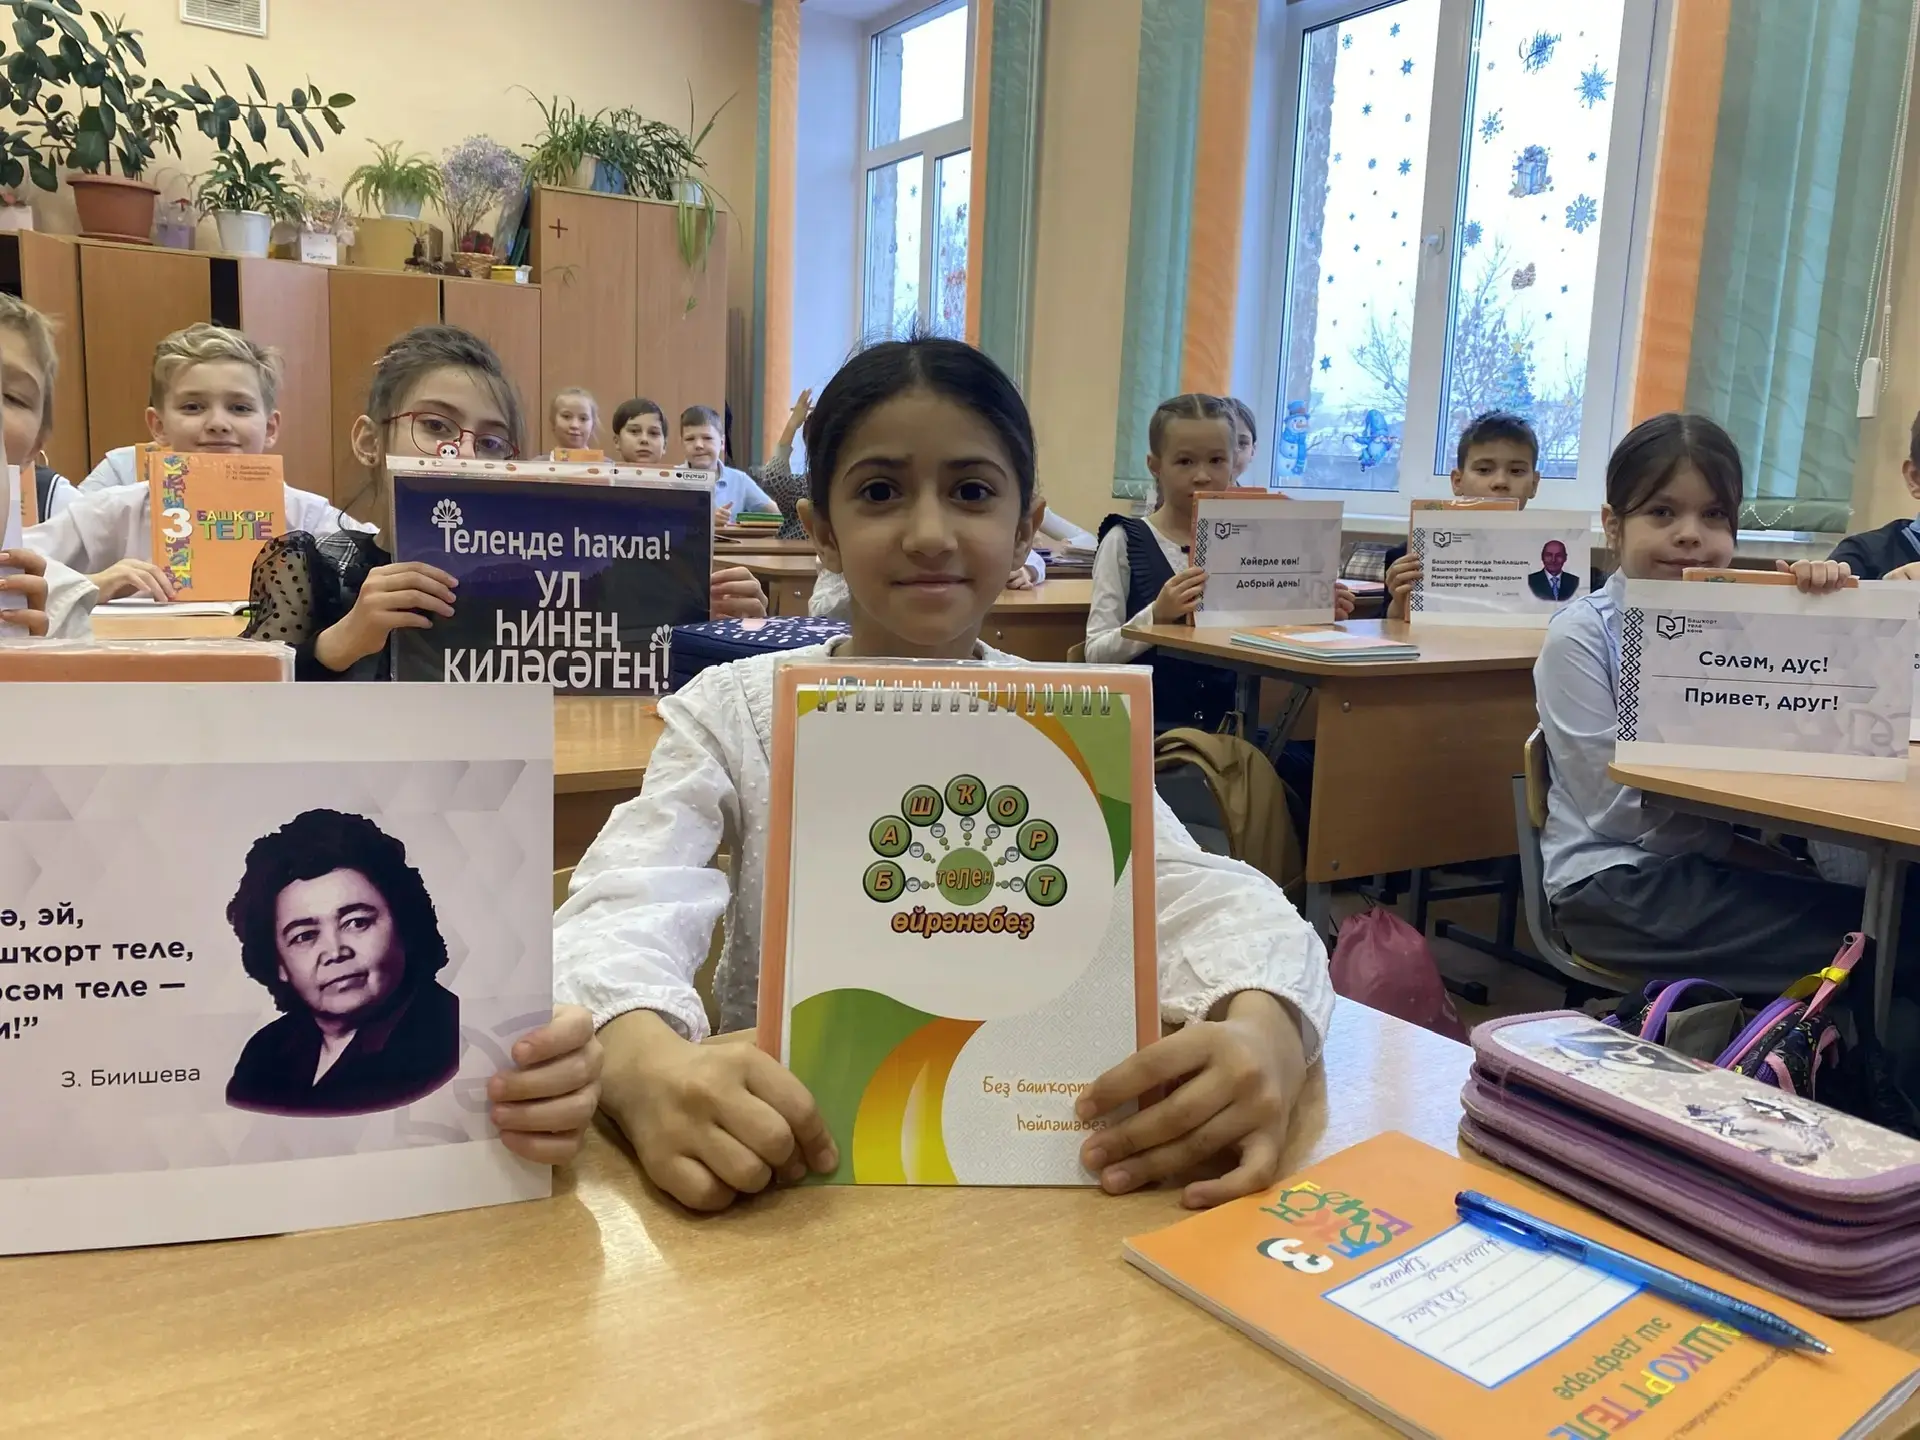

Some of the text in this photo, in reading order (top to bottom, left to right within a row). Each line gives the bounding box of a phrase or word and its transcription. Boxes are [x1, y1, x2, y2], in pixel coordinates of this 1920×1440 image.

[162, 508, 192, 538] 3
[199, 520, 272, 540] ТЕЛЕ
[437, 521, 671, 560] Телеңде һаҡла!
[534, 570, 581, 609] УЛ
[1236, 578, 1300, 589] Добрый день!
[1699, 651, 1774, 672] Сәләм,
[1685, 688, 1838, 712] Привет, друг!
[37, 901, 84, 929] эй,
[112, 941, 193, 962] теле,
[0, 983, 63, 1001] сәм
[75, 979, 148, 999] теле
[91, 1068, 201, 1086] Биишева
